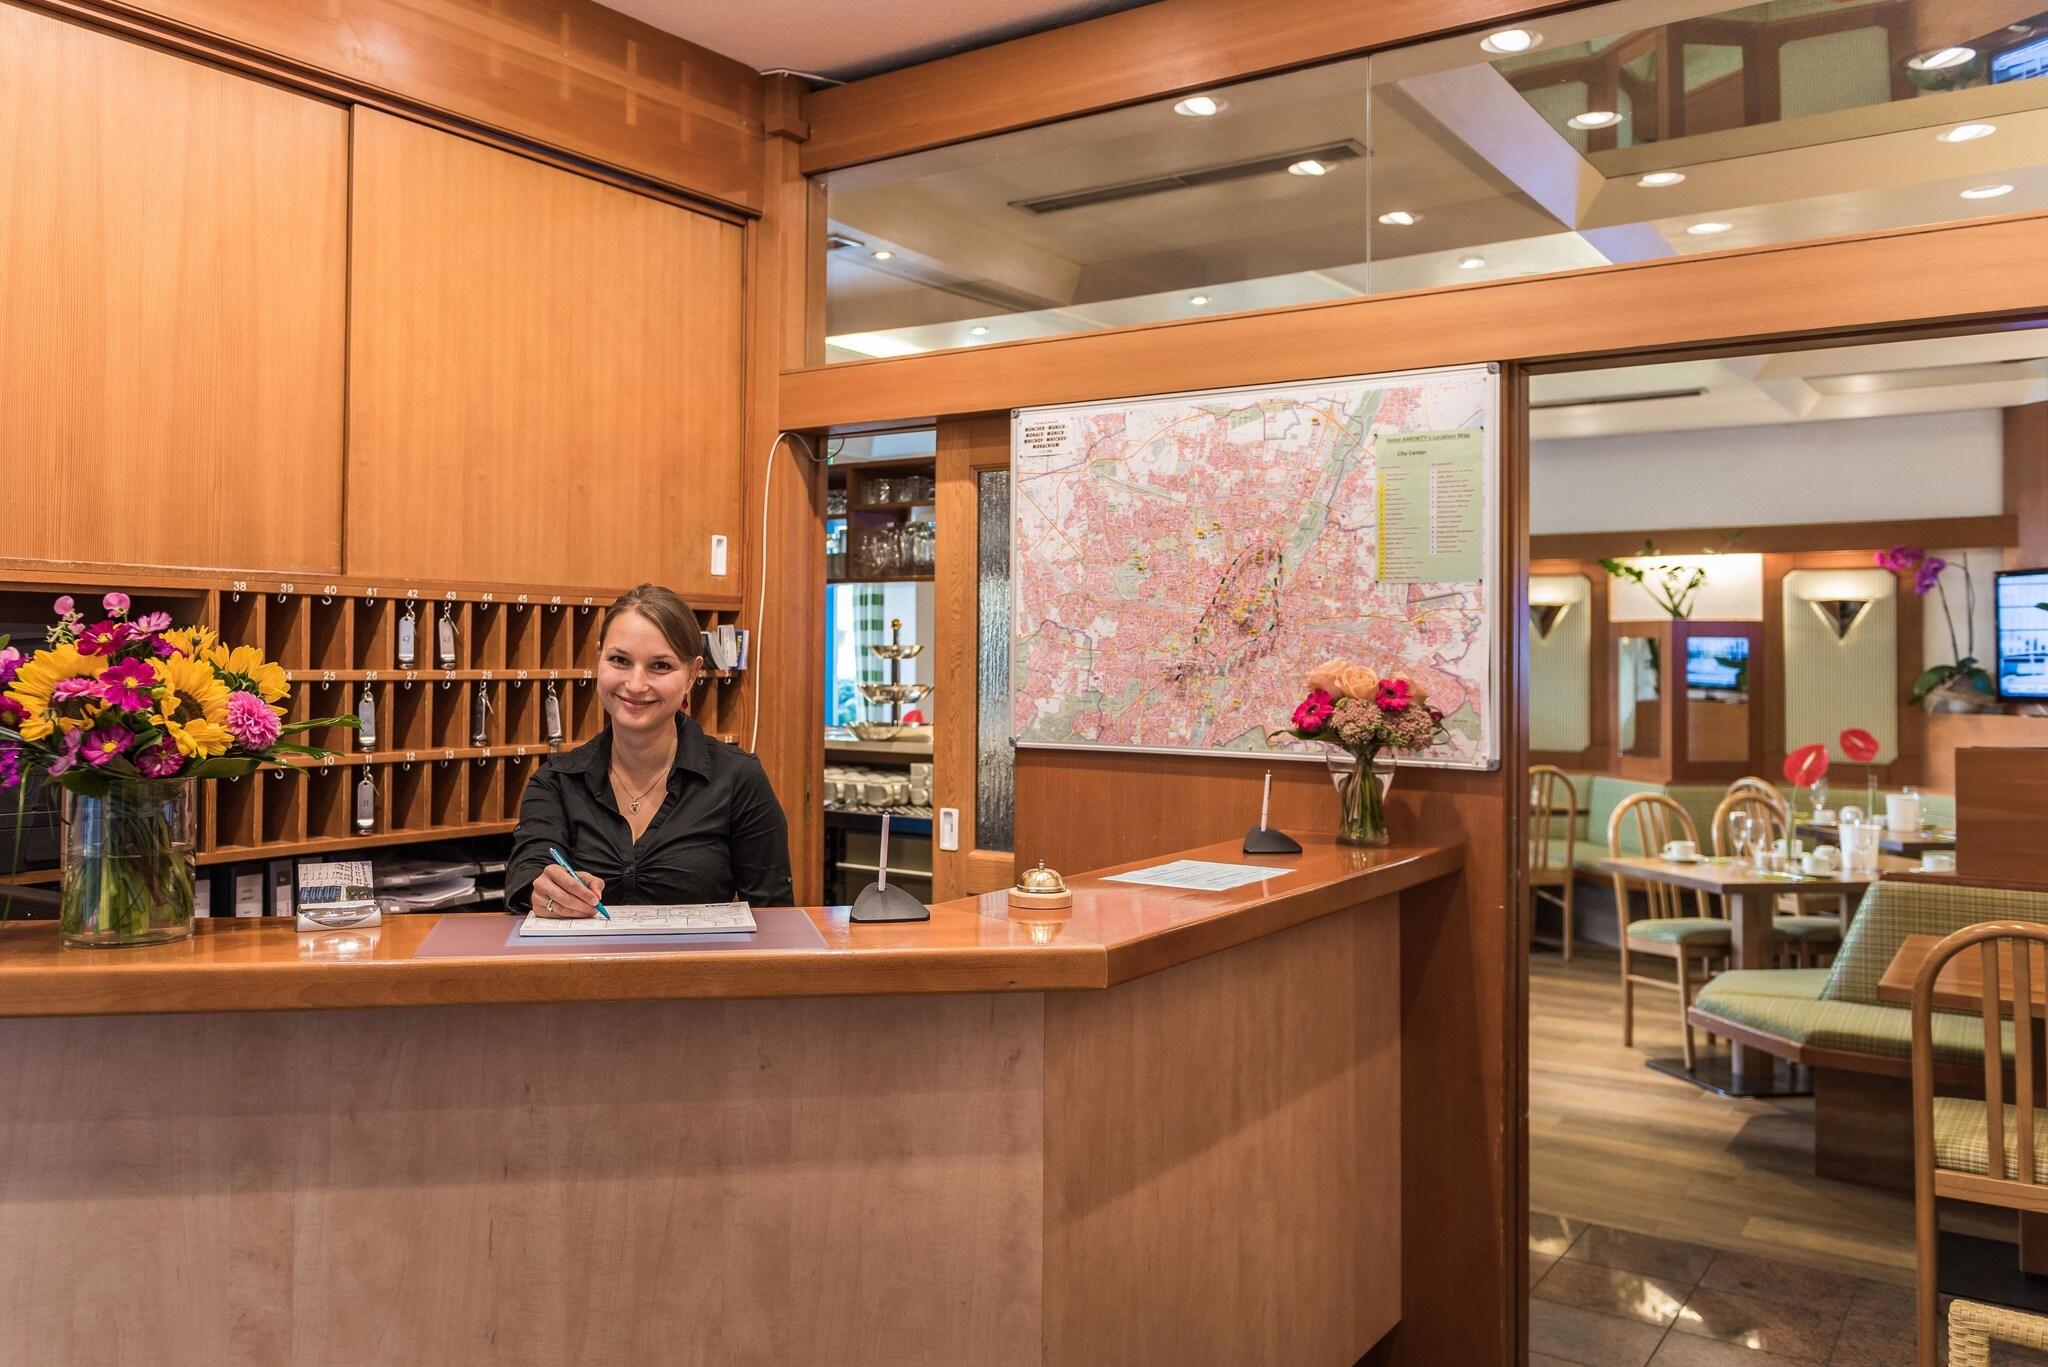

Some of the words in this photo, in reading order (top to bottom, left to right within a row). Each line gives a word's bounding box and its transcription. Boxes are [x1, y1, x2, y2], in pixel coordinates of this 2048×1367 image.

[233, 581, 247, 591] 38
[280, 584, 294, 593] 39
[324, 586, 337, 594] 40
[366, 588, 377, 596] 41
[407, 589, 418, 598] 42
[446, 591, 456, 600] 43
[482, 593, 492, 601] 44
[518, 594, 528, 603] 45
[552, 596, 561, 604] 46
[323, 671, 336, 680] 25
[366, 671, 378, 680] 26
[406, 671, 418, 680] 27
[445, 671, 456, 680] 28
[482, 671, 492, 679] 29
[516, 670, 528, 679] 30
[550, 670, 558, 678] 31
[583, 670, 592, 678] 32
[445, 750, 454, 759] 13
[482, 748, 490, 757] 14
[517, 747, 526, 755] 15
[323, 756, 335, 766] 10
[365, 754, 373, 764] 11
[406, 752, 416, 761] 12
